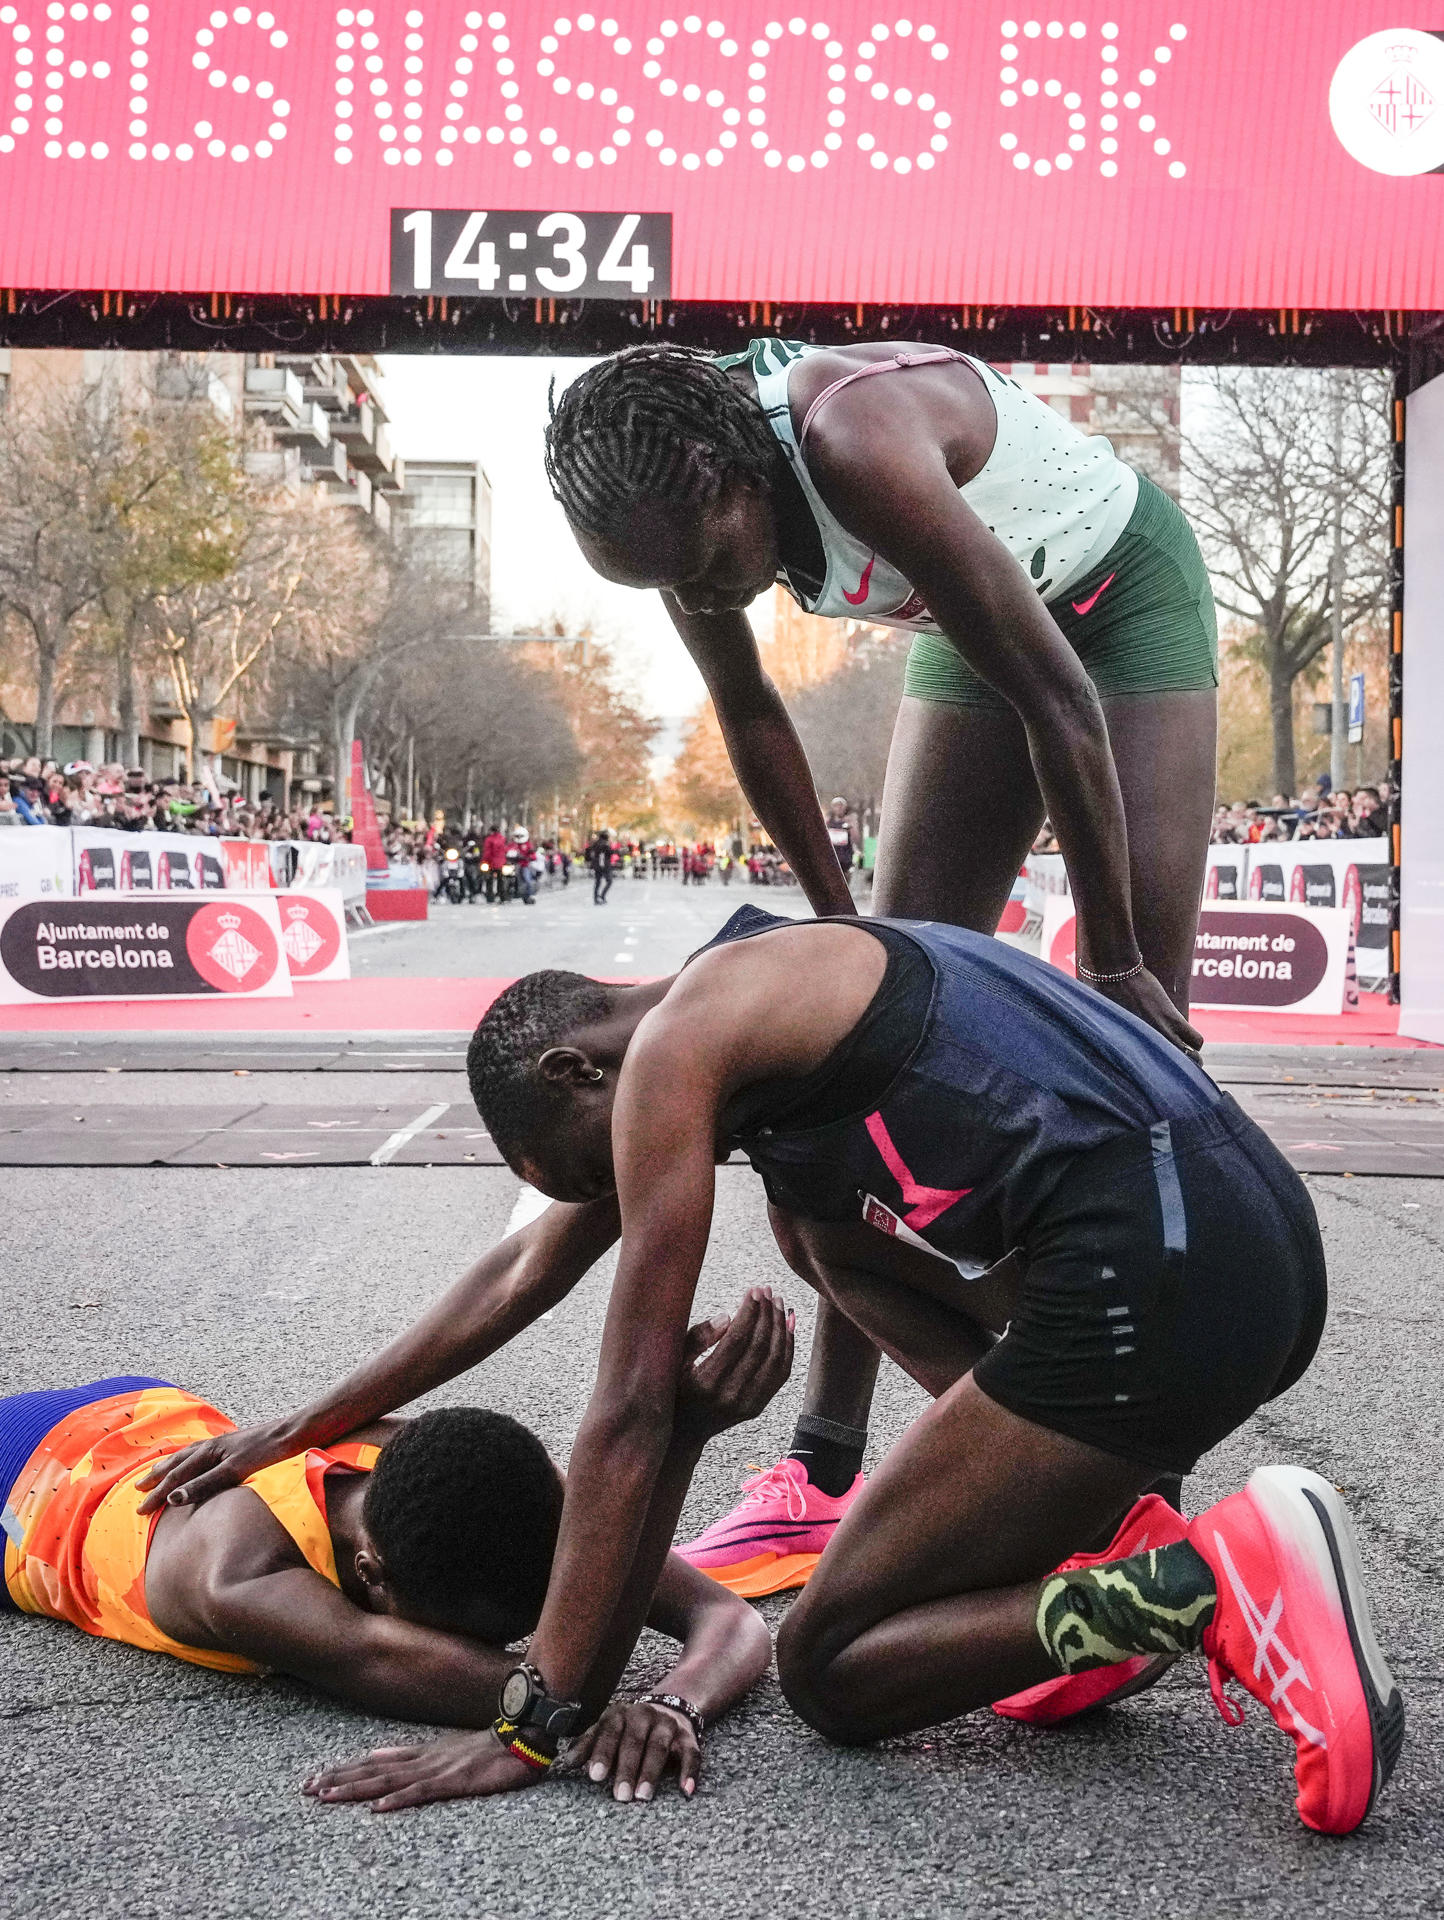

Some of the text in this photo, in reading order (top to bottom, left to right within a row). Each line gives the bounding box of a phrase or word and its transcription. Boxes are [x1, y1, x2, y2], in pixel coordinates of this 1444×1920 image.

[335, 9, 951, 174] NASSOS
[1000, 20, 1187, 178] 5K
[403, 211, 655, 292] 14:34
[36, 922, 170, 945] Ajuntament de
[1195, 932, 1296, 952] ntament de
[37, 944, 174, 970] Barcelona
[1191, 954, 1293, 980] rcelona
